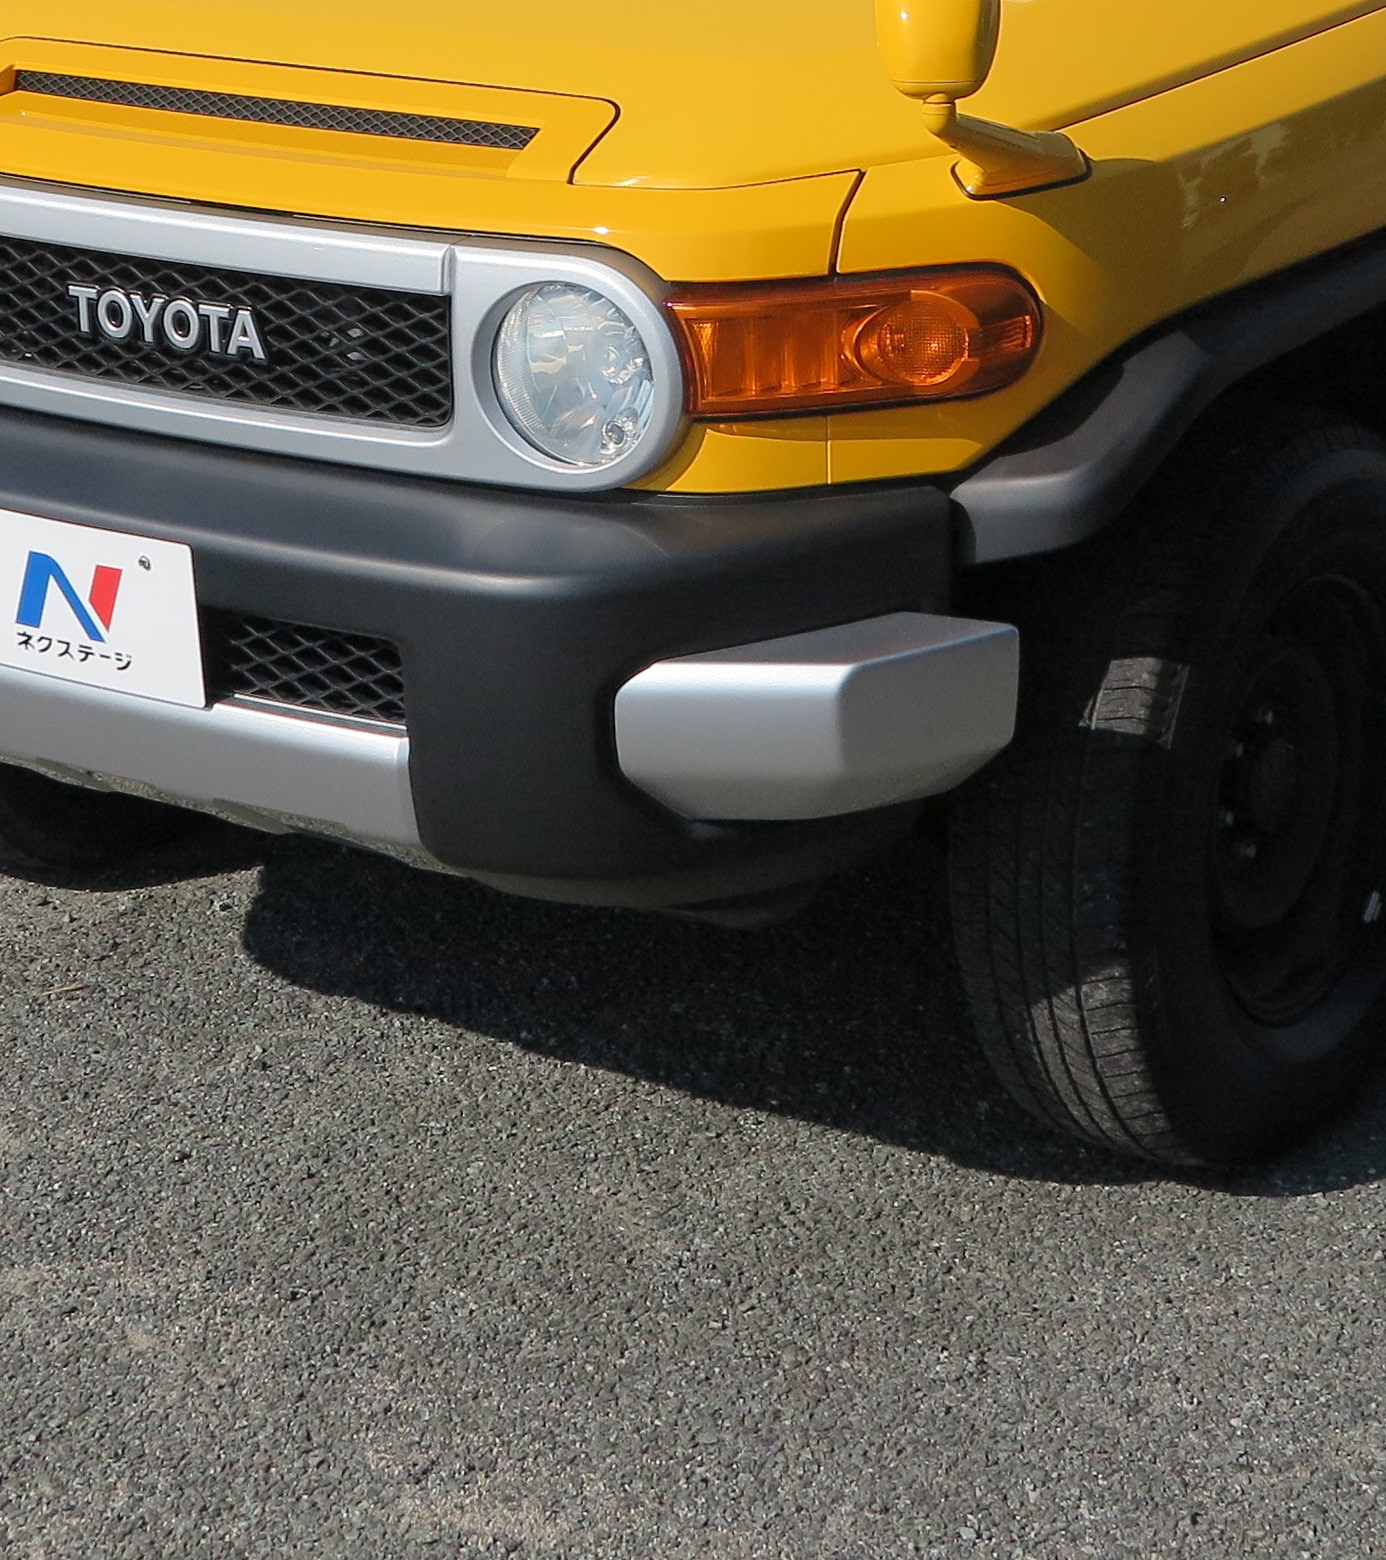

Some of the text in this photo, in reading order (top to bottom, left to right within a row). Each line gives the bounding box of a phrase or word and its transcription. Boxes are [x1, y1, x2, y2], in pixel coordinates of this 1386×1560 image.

[67, 282, 267, 362] TOYOTA
[16, 631, 133, 671] ネクステージ
